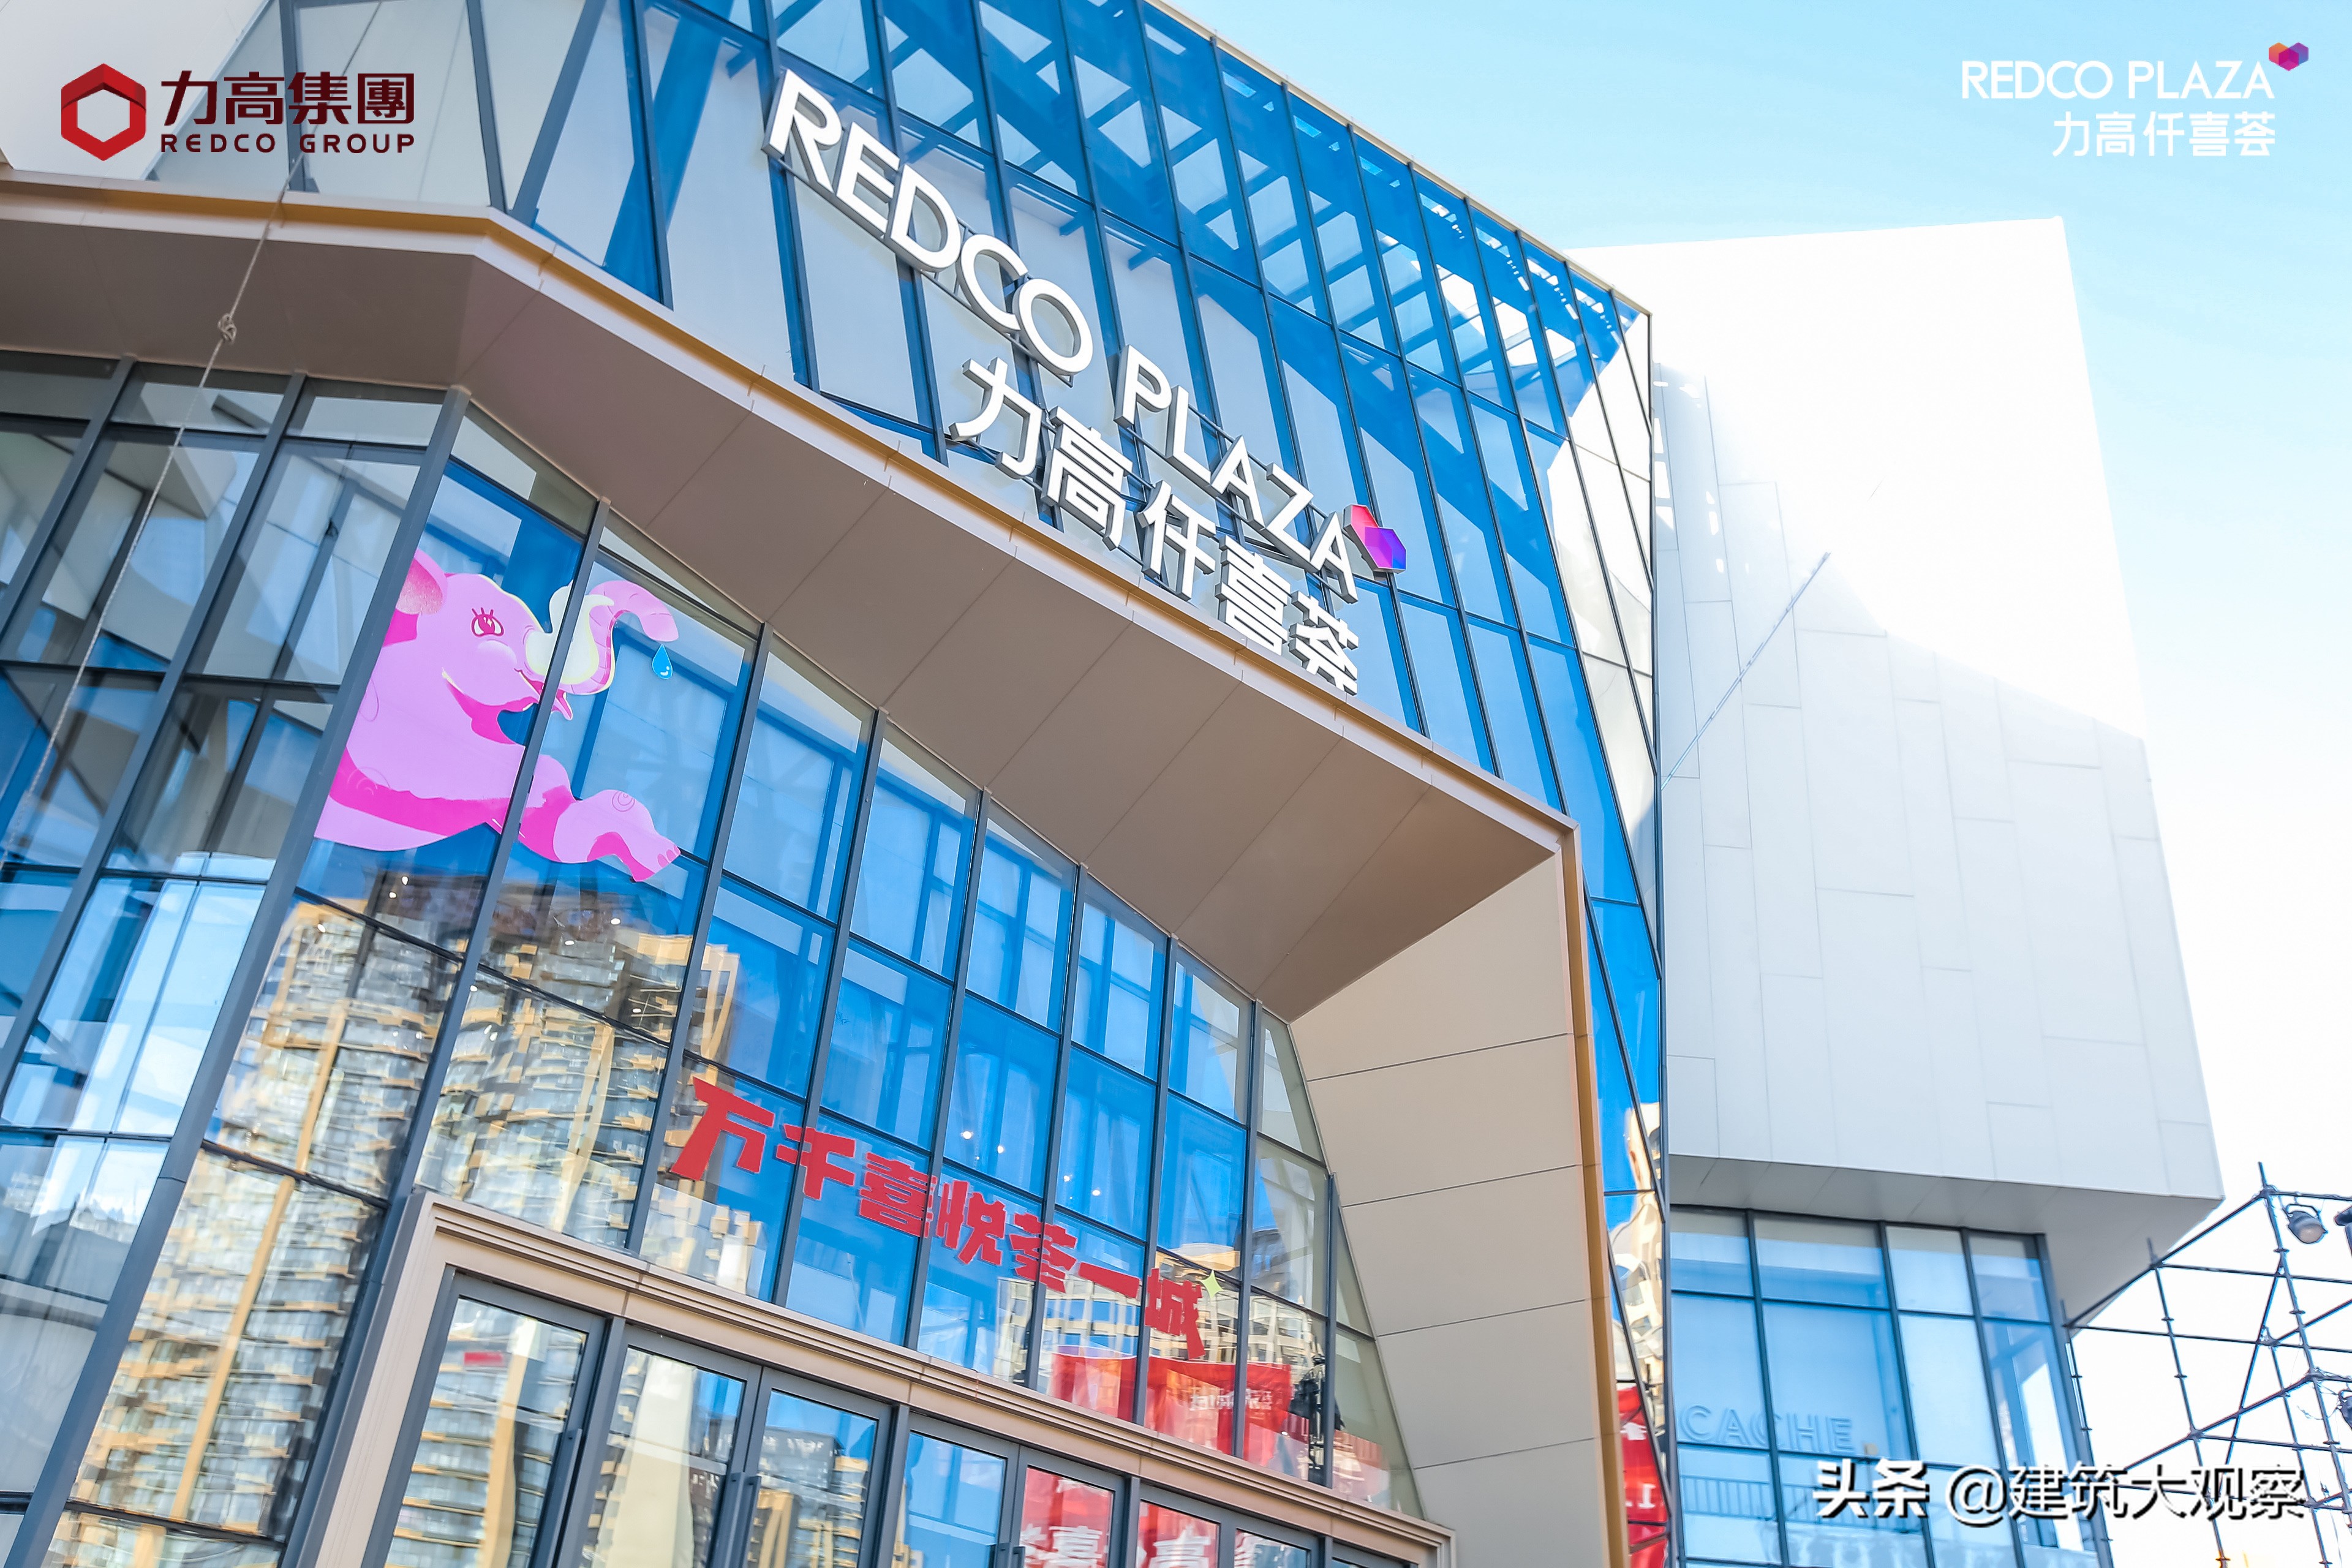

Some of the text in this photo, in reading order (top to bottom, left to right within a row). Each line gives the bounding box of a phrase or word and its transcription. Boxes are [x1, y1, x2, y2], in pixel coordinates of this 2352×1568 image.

[761, 69, 1359, 604] REDCO PLAZA
[948, 356, 1359, 696] 力高仟喜荟
[670, 1076, 1205, 1360] 万千喜悦荟一城
